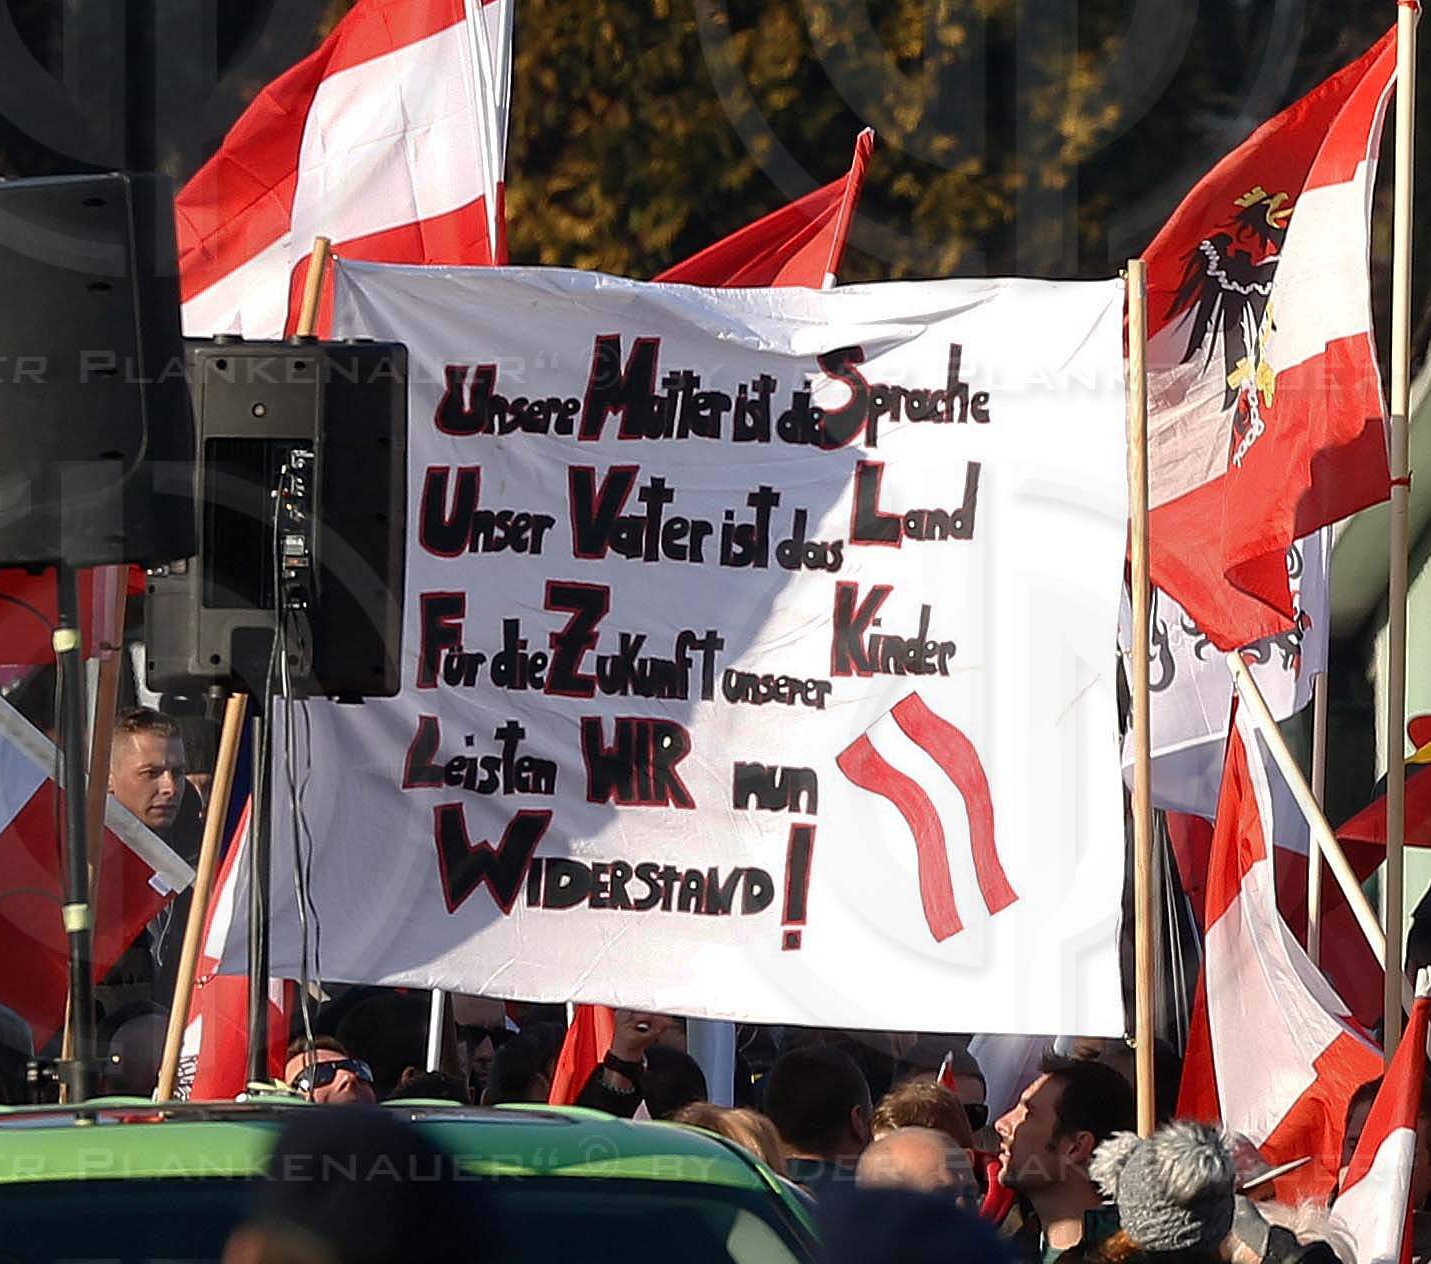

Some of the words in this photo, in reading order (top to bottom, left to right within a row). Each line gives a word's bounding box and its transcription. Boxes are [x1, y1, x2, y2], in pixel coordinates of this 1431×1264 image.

[435, 364, 581, 436] Unsere
[731, 374, 777, 442] ist
[817, 344, 990, 450] Sprache
[419, 465, 556, 557] Unser
[568, 464, 713, 563] Vater
[720, 485, 781, 568] ist
[775, 508, 844, 572] das
[849, 460, 981, 549] Land
[416, 591, 488, 689] Für
[488, 617, 549, 690] die
[722, 667, 833, 711] unserer
[830, 580, 957, 678] Kinder
[402, 715, 558, 796] Leisten
[580, 715, 697, 809] WIR
[732, 760, 819, 816] nun
